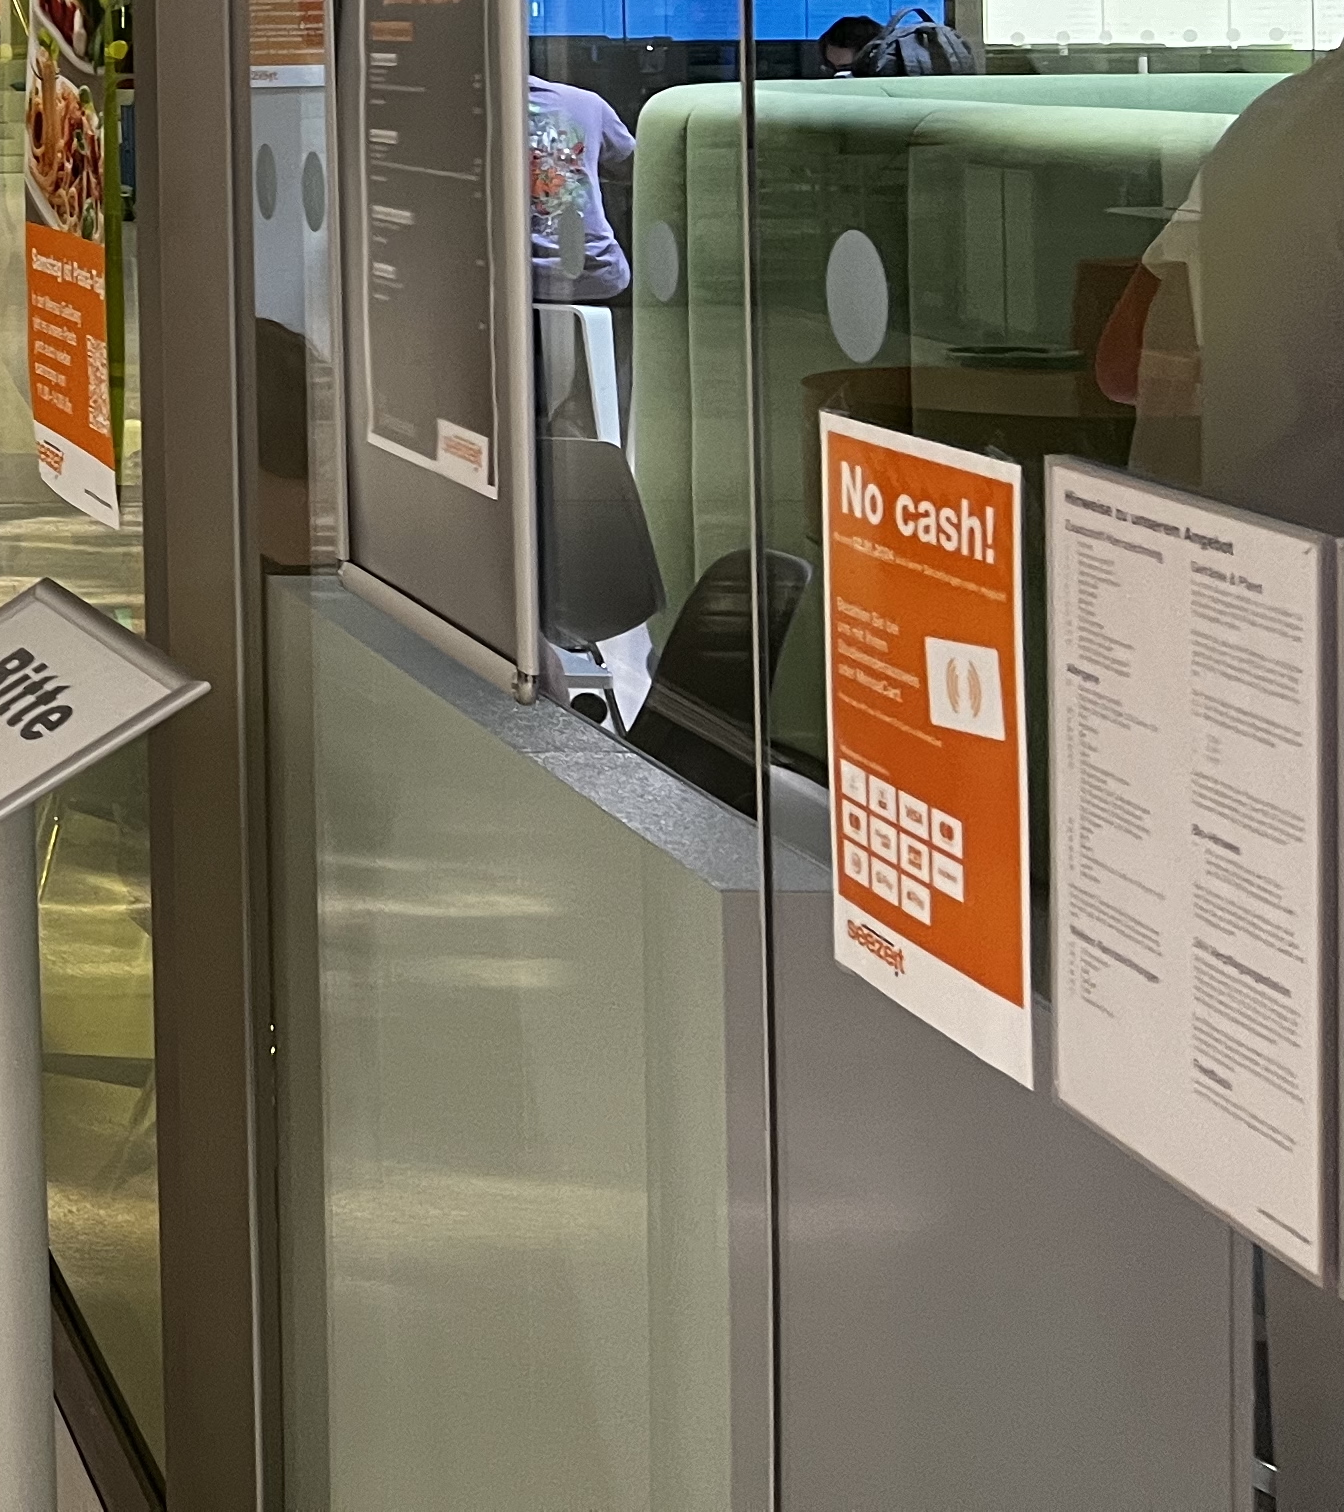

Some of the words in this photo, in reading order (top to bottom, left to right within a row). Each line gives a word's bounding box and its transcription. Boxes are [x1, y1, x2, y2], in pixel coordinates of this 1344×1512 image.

[841, 461, 883, 525] No
[896, 494, 994, 564] cash!
[847, 919, 905, 977] seezeit
